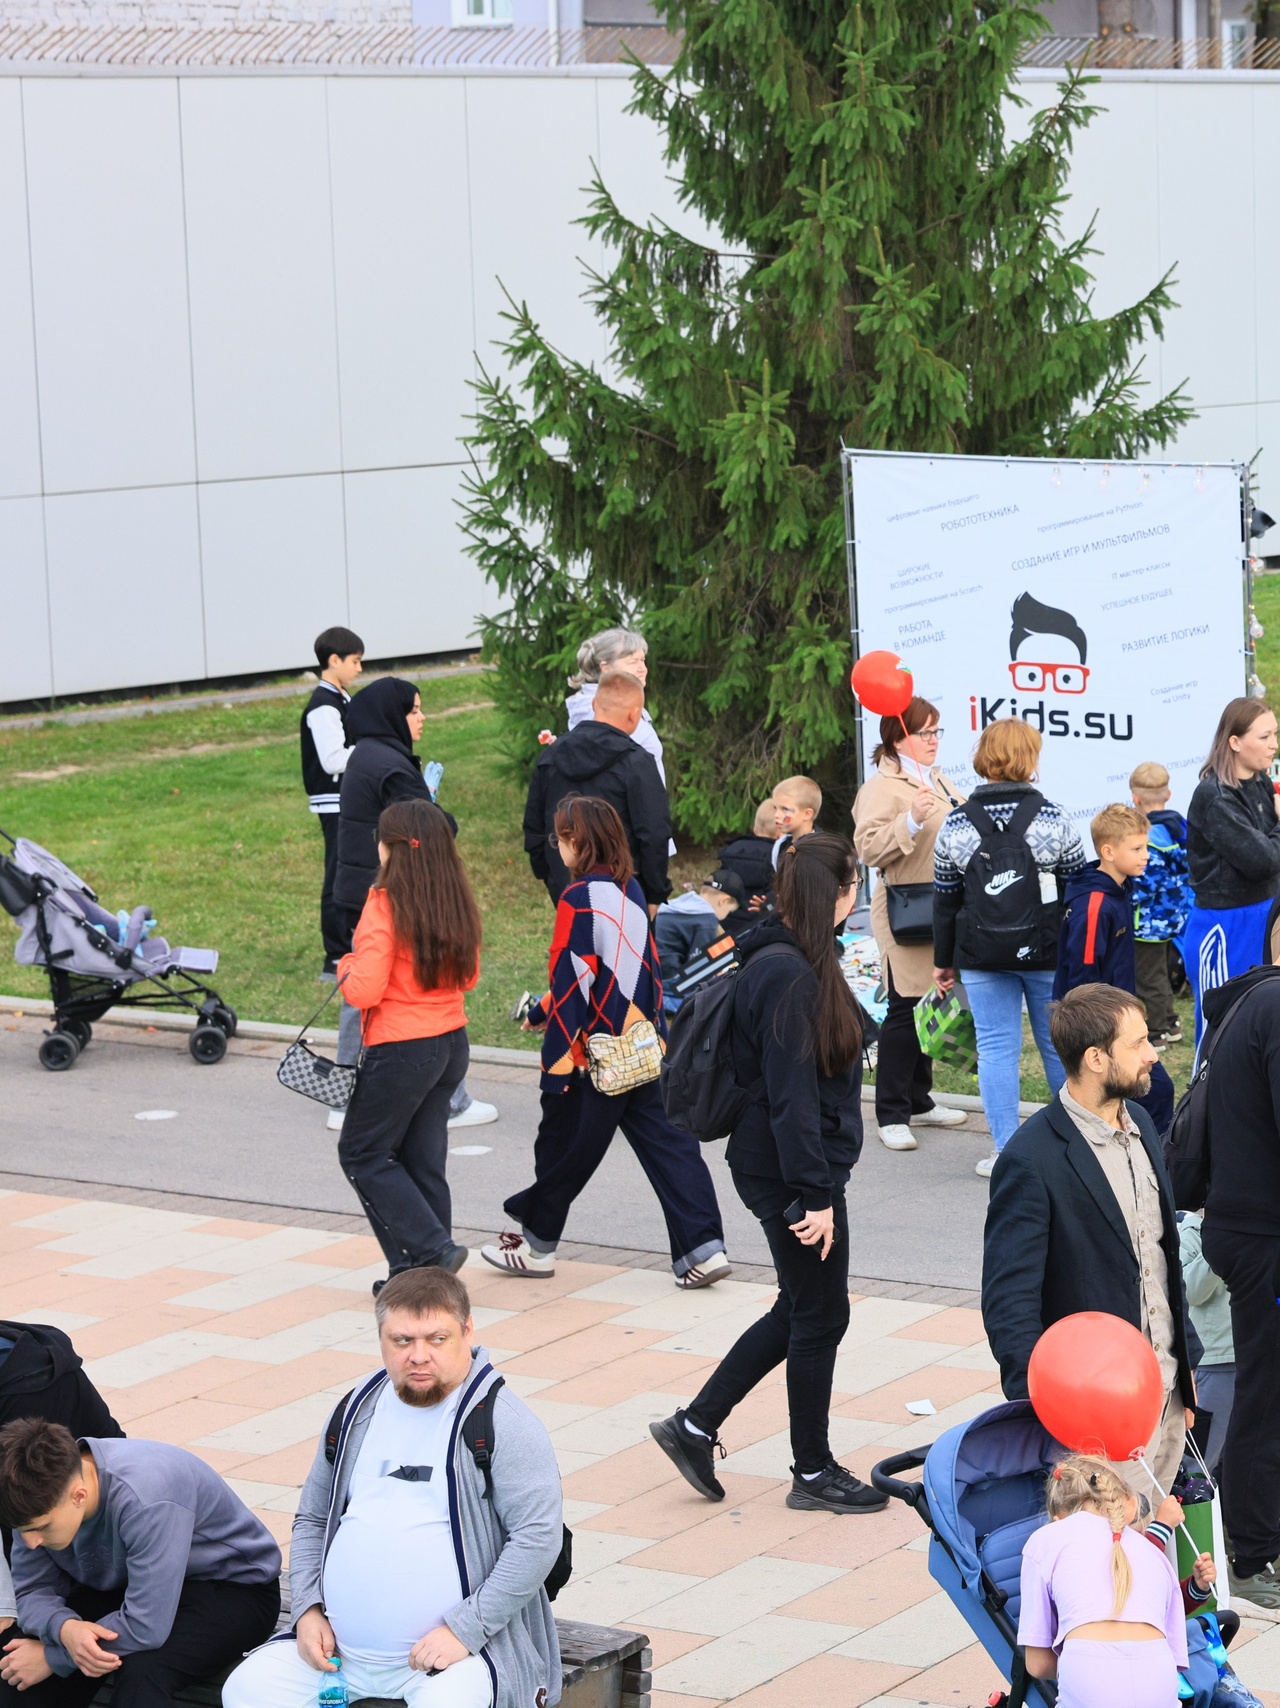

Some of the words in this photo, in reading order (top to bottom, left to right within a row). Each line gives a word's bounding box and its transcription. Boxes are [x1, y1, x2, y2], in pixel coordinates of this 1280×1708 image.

[886, 509, 921, 523] цифровые
[921, 502, 947, 513] навыки
[947, 493, 981, 507] будущего
[940, 504, 1020, 532] РОБОТОТЕХНИКА
[1037, 511, 1105, 534] программирование
[1105, 508, 1115, 516] на
[1011, 550, 1062, 572] СОЗДАНИЕ
[1062, 545, 1081, 559] ИГР
[1082, 543, 1090, 554] И
[1090, 523, 1171, 552] МУЛЬТФИЛЬМОВ
[889, 570, 945, 591] ВОЗМОЖНОСТИ
[897, 562, 932, 578] ШИРОКИЕ
[1119, 562, 1171, 579] мастер-классы
[884, 594, 949, 615] программирование
[959, 584, 984, 597] Scratch
[1100, 595, 1140, 612] УСПЕШНОЕ
[1141, 587, 1174, 602] БУДУЩЕЕ
[898, 619, 933, 635] РАБОТА
[1121, 633, 1170, 653] РАЗВИТИЕ
[1171, 623, 1210, 642] ЛОГИКИ
[893, 641, 900, 652] В
[901, 630, 947, 649] КОМАНДЕ
[1150, 683, 1185, 697] Создание
[1185, 680, 1199, 690] игр
[1162, 697, 1172, 705] на
[1172, 693, 1192, 703] Unity
[990, 869, 1017, 888] NIKE
